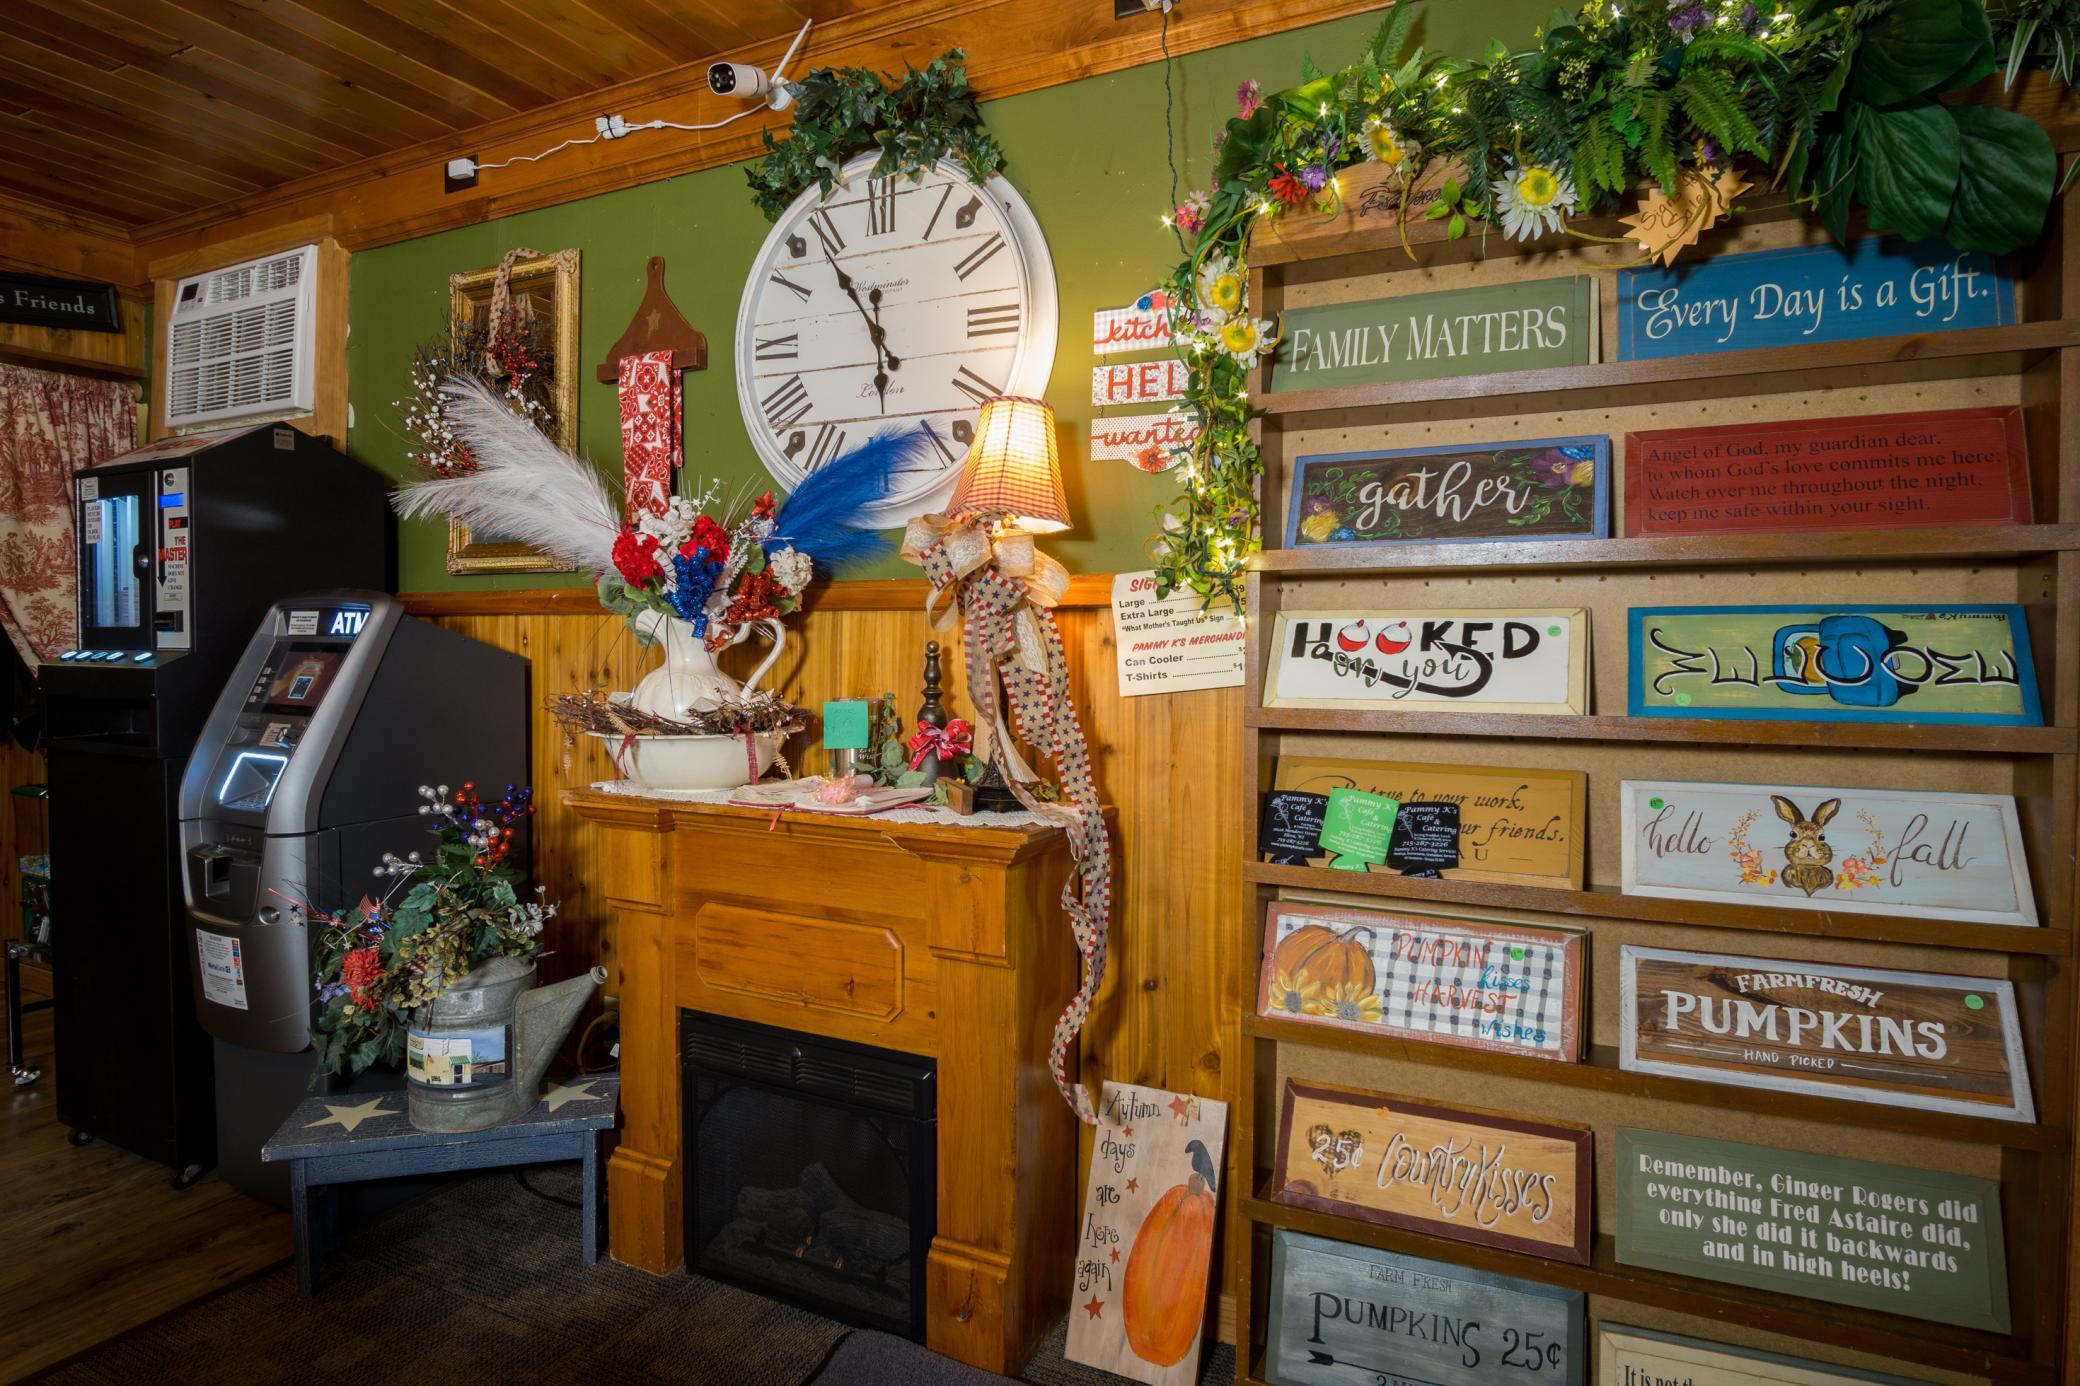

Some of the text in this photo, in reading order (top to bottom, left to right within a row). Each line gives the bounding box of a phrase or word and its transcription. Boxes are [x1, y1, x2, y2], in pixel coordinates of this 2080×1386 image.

[14, 290, 95, 315] Friends
[1637, 251, 1989, 344] Every Day is a Gift.
[1094, 315, 1173, 345] kitch
[1289, 305, 1568, 373] FAMILY MATTERS
[1107, 363, 1187, 400] HEL
[1648, 446, 1697, 463] Angel
[1704, 443, 1722, 458] of
[1775, 440, 1801, 456] my
[1808, 434, 1888, 455] guardian
[1648, 468, 1664, 481] to
[1669, 465, 1721, 479] whom
[1785, 459, 1825, 474] love
[1829, 454, 1911, 472] commits
[1917, 454, 1946, 467] me
[1354, 460, 1531, 531] gather
[1648, 485, 1701, 500] Watch
[1706, 484, 1746, 498] over
[1751, 483, 1776, 496] me
[1782, 475, 1883, 496] throughout
[1889, 474, 1920, 490] the
[1648, 496, 1931, 524] keep me safe within your sight.
[174, 536, 187, 546] THE
[1119, 600, 1145, 609] Large
[1120, 607, 1174, 620] Extra Large
[330, 612, 369, 634] ATM
[1143, 621, 1171, 630] Mother's
[1172, 617, 1195, 627] Taught
[1209, 615, 1224, 625] Sign
[1132, 639, 1169, 652] PAMMY
[1189, 631, 1245, 646] MERCHANDI
[1125, 654, 1184, 667] Can Cooler
[1650, 627, 2020, 697] WELCOME
[1126, 671, 1168, 682] T-Shirts
[1332, 651, 1471, 700] on you
[1281, 794, 1313, 805] Pammy
[1404, 806, 1457, 815] Pammy K's
[1474, 784, 1529, 812] work,
[1422, 825, 1457, 835] Catering
[1472, 816, 1565, 847] friends.
[1642, 804, 1978, 888] hello fall
[1394, 932, 1495, 970] PUMPKIN
[1478, 965, 1532, 991] kisses
[1414, 979, 1517, 1015] HARVEST
[1481, 1019, 1547, 1043] wishes
[1660, 989, 1948, 1062] PUMPKINS
[1744, 1049, 1835, 1069] HAND PICKED
[1105, 1090, 1161, 1125] Autumn
[1101, 1129, 1136, 1174] days
[1312, 1134, 1364, 1169] 25¢
[1096, 1184, 1120, 1207] are
[1639, 1153, 1978, 1225] Remember, Ginger Rogers did
[1084, 1212, 1120, 1248] here
[1647, 1181, 1971, 1252] everything Fred Astaire did,
[1659, 1208, 1959, 1274] only she did it backwards
[1077, 1259, 1113, 1292] again
[1369, 1264, 1453, 1293] FARM FRESH
[1703, 1238, 1911, 1292] and in high heels!
[1306, 1291, 1562, 1372] PUMPKINS 25¢
